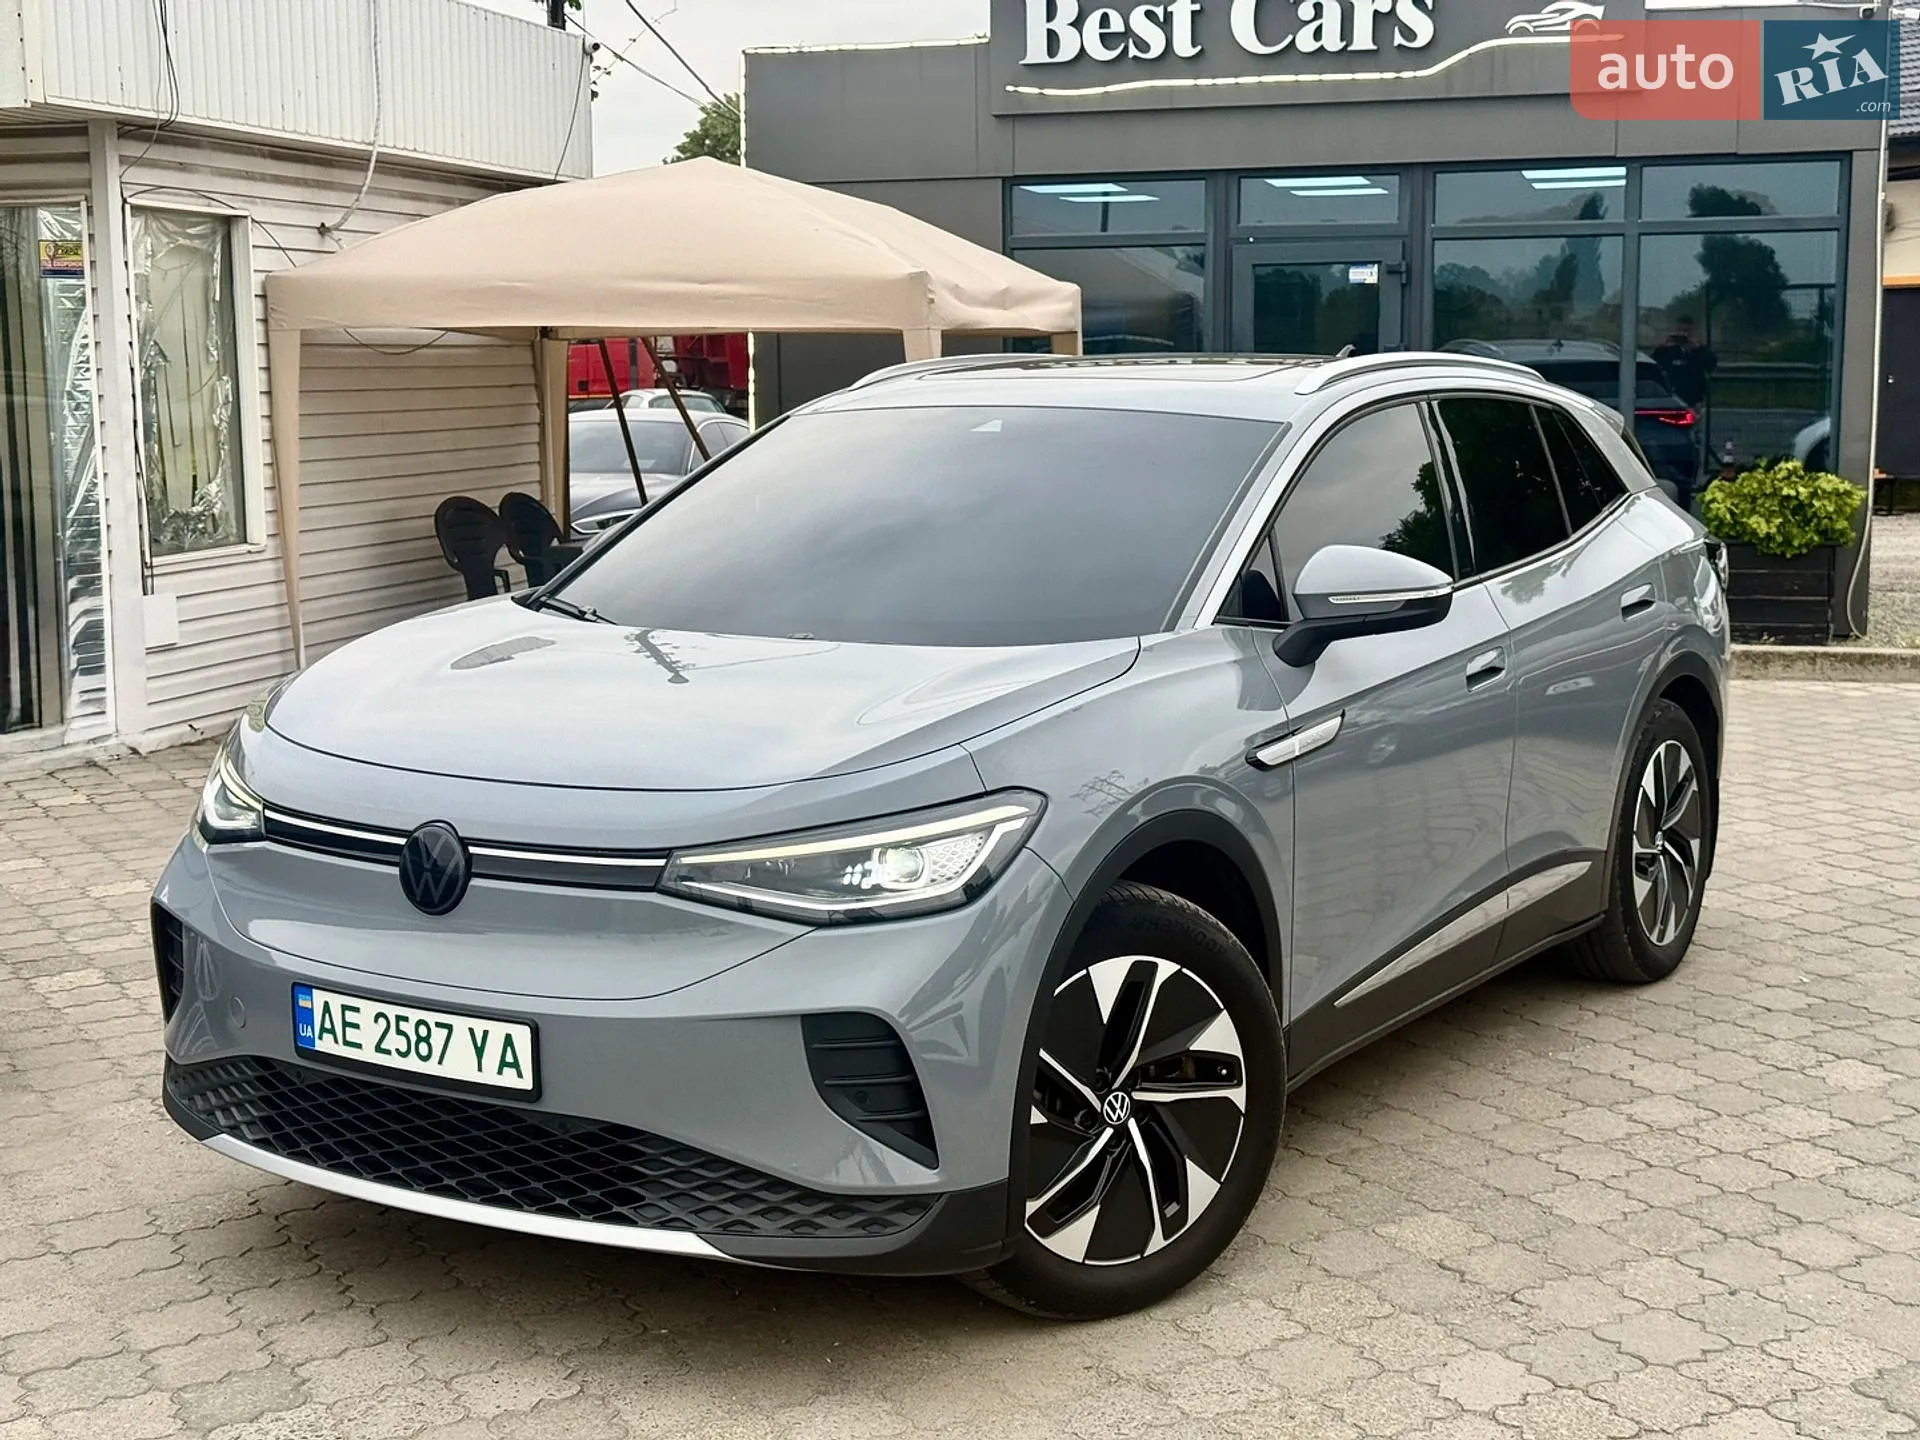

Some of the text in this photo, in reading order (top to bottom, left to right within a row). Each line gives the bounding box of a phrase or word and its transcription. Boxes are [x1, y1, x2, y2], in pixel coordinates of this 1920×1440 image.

[1019, 0, 1436, 65] Best Cars
[299, 1024, 314, 1039] UA
[317, 1000, 524, 1079] AE 2587 YA
